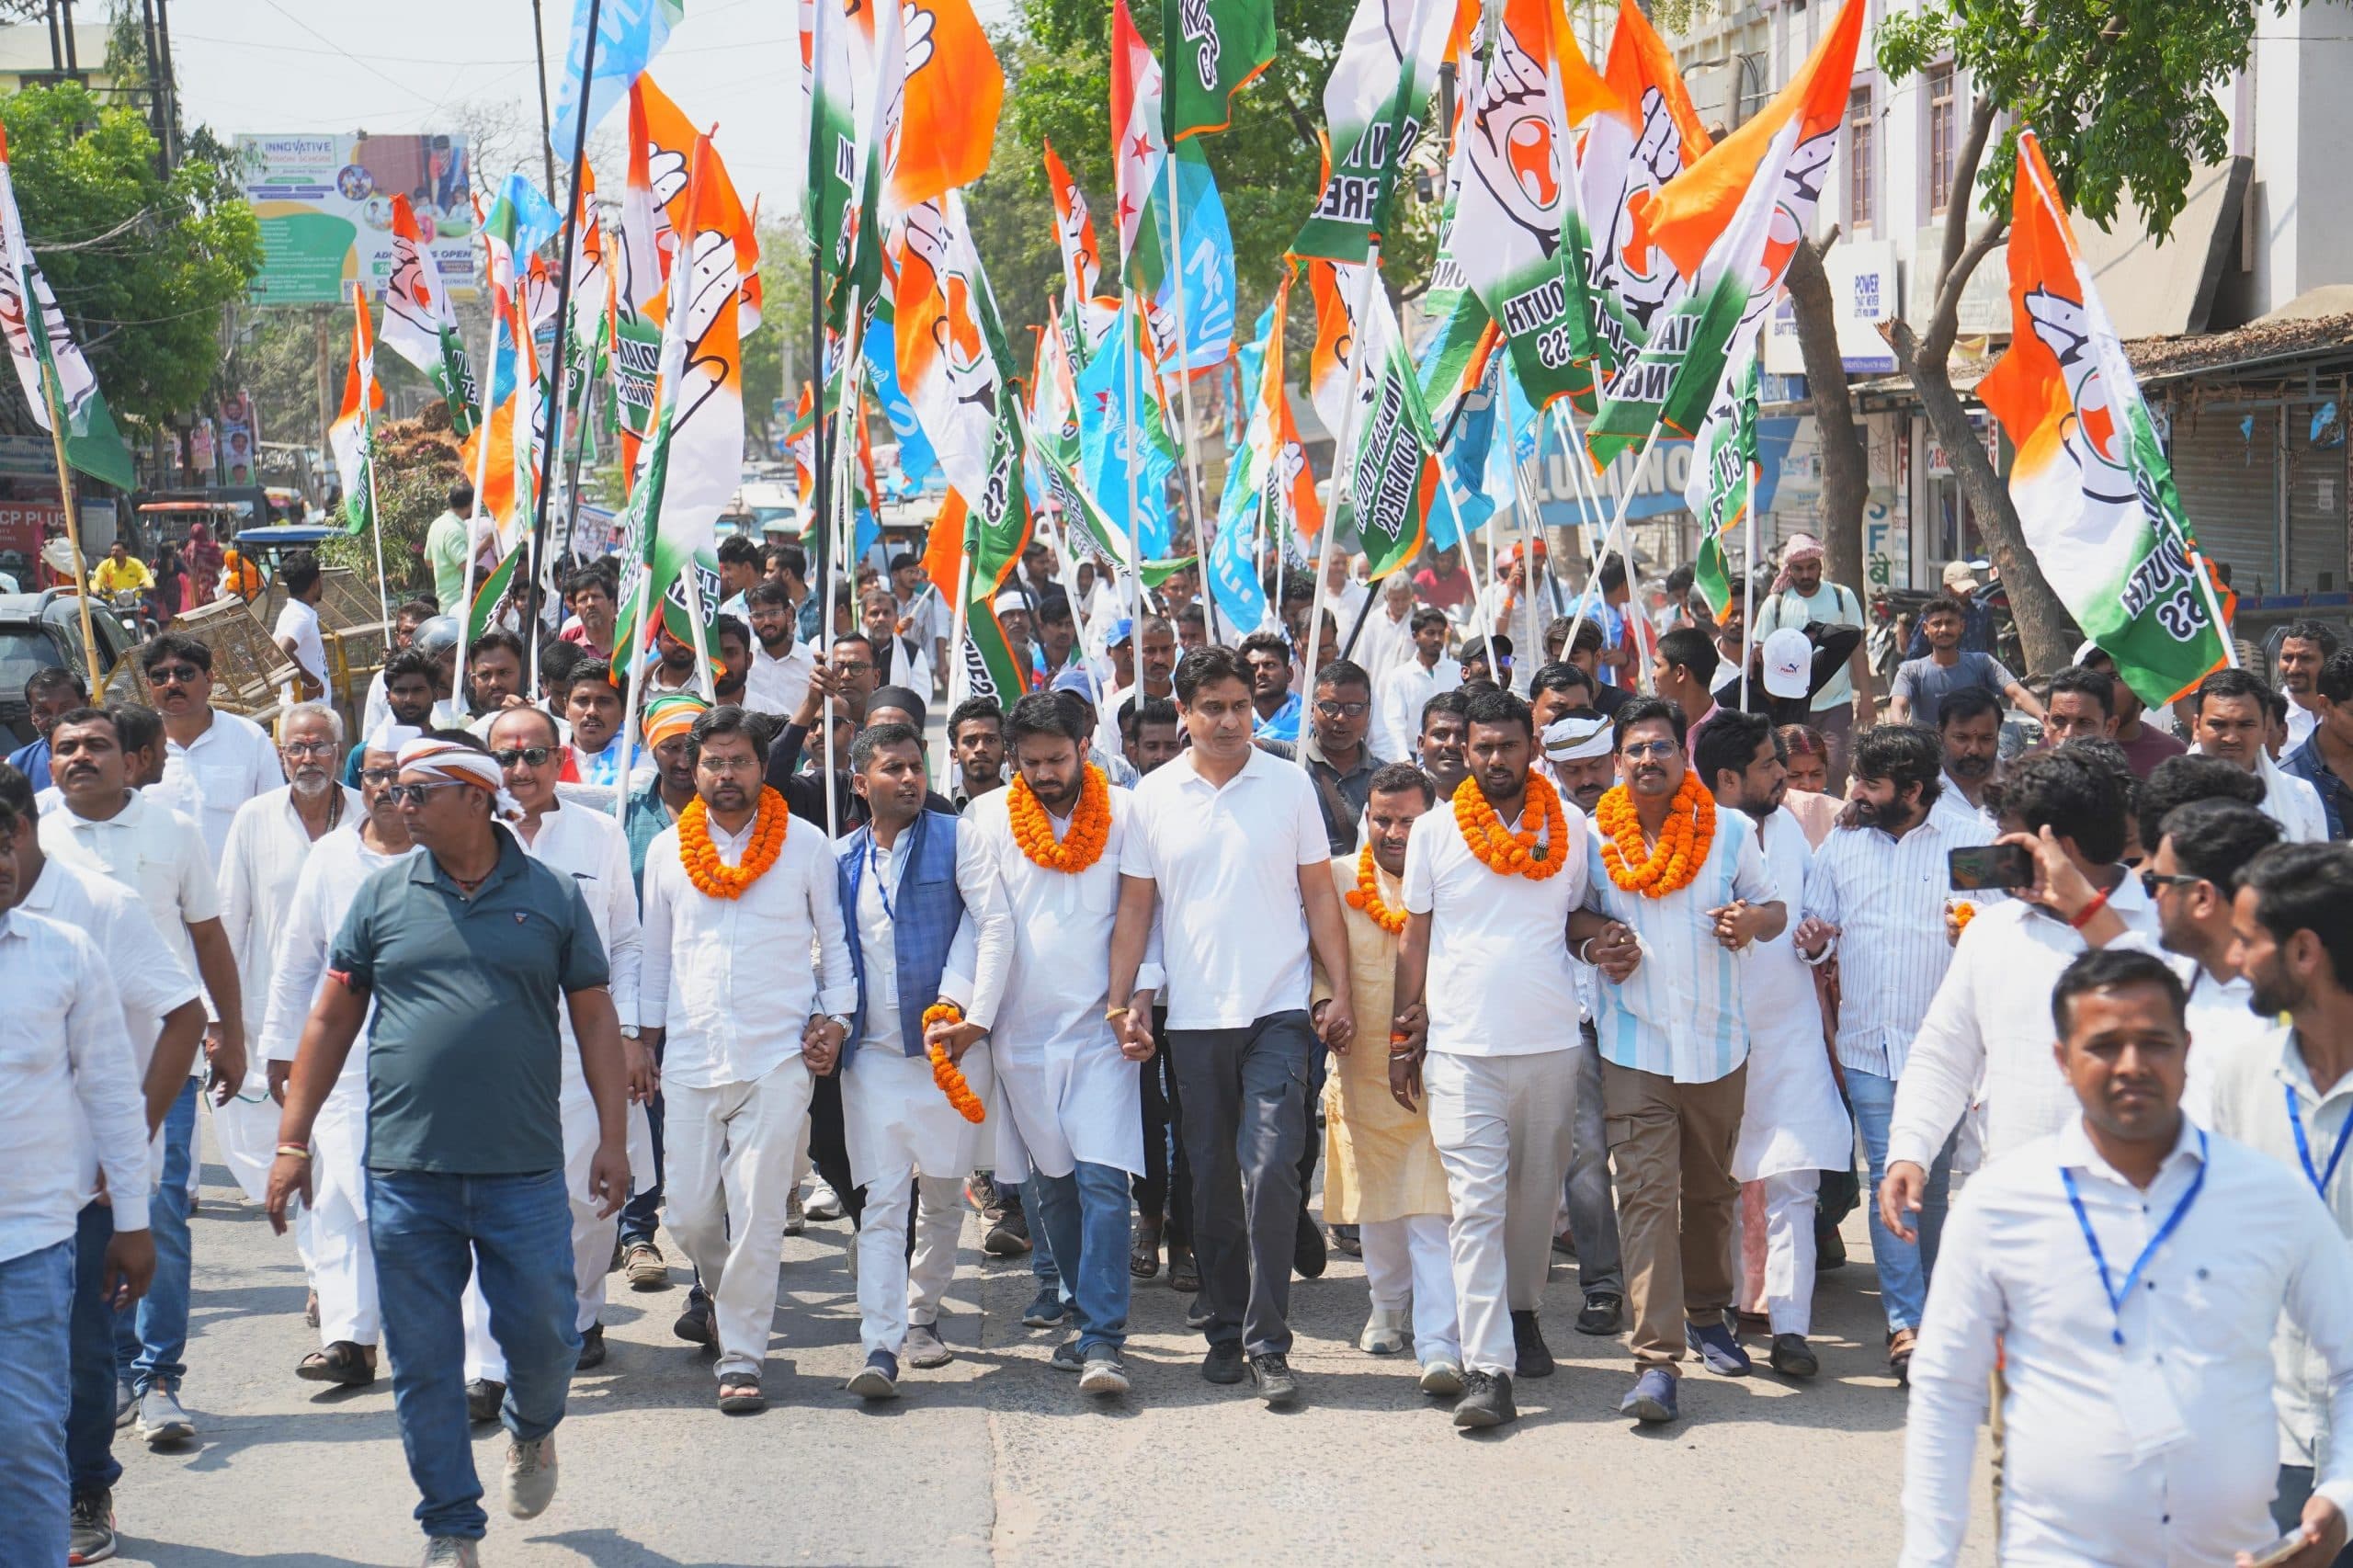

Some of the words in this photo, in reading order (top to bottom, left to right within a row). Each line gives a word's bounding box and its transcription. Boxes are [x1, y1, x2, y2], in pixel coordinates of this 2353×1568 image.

[265, 140, 331, 154] INNOVATIVE
[441, 250, 472, 258] OPEN
[1855, 273, 1879, 294] POWER
[1775, 322, 1799, 336] BATTE
[1528, 445, 1694, 503] LUMINO
